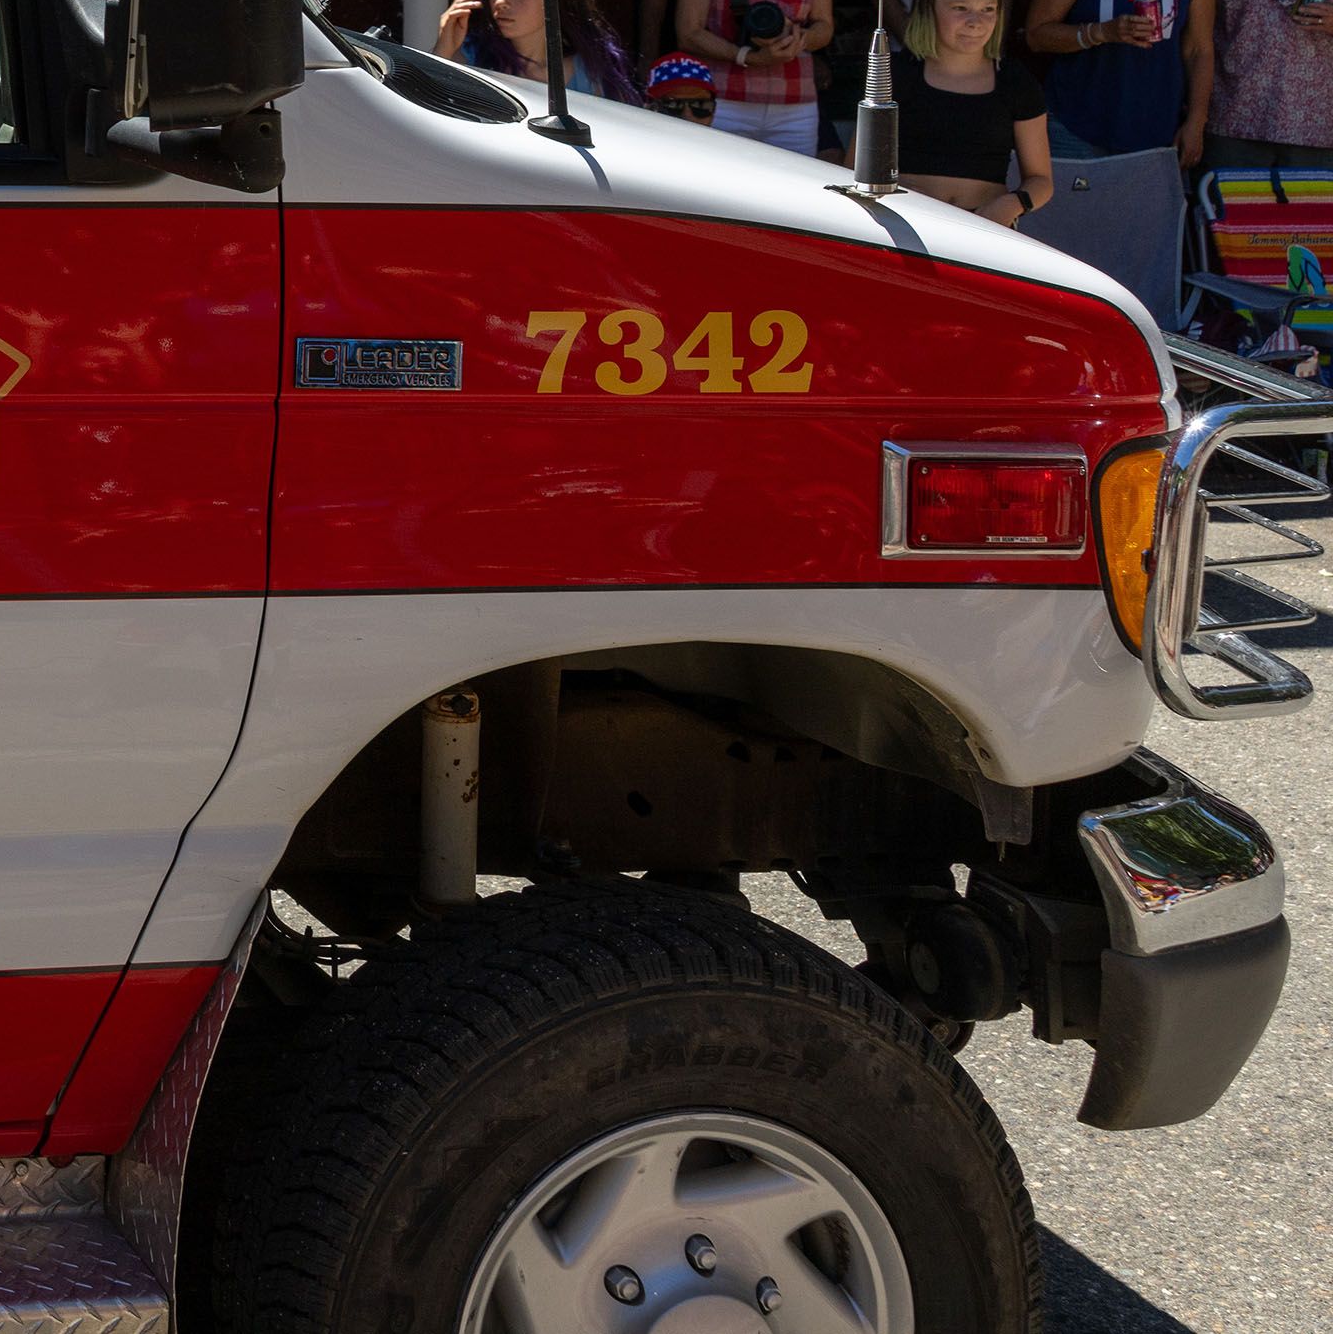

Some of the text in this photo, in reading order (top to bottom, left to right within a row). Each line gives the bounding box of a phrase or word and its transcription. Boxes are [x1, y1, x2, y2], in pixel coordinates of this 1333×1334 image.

[1247, 233, 1288, 247] Tommy
[342, 344, 451, 370] LEADER
[525, 309, 814, 395] 7342
[342, 373, 451, 387] EMERGENCY VEHICLES
